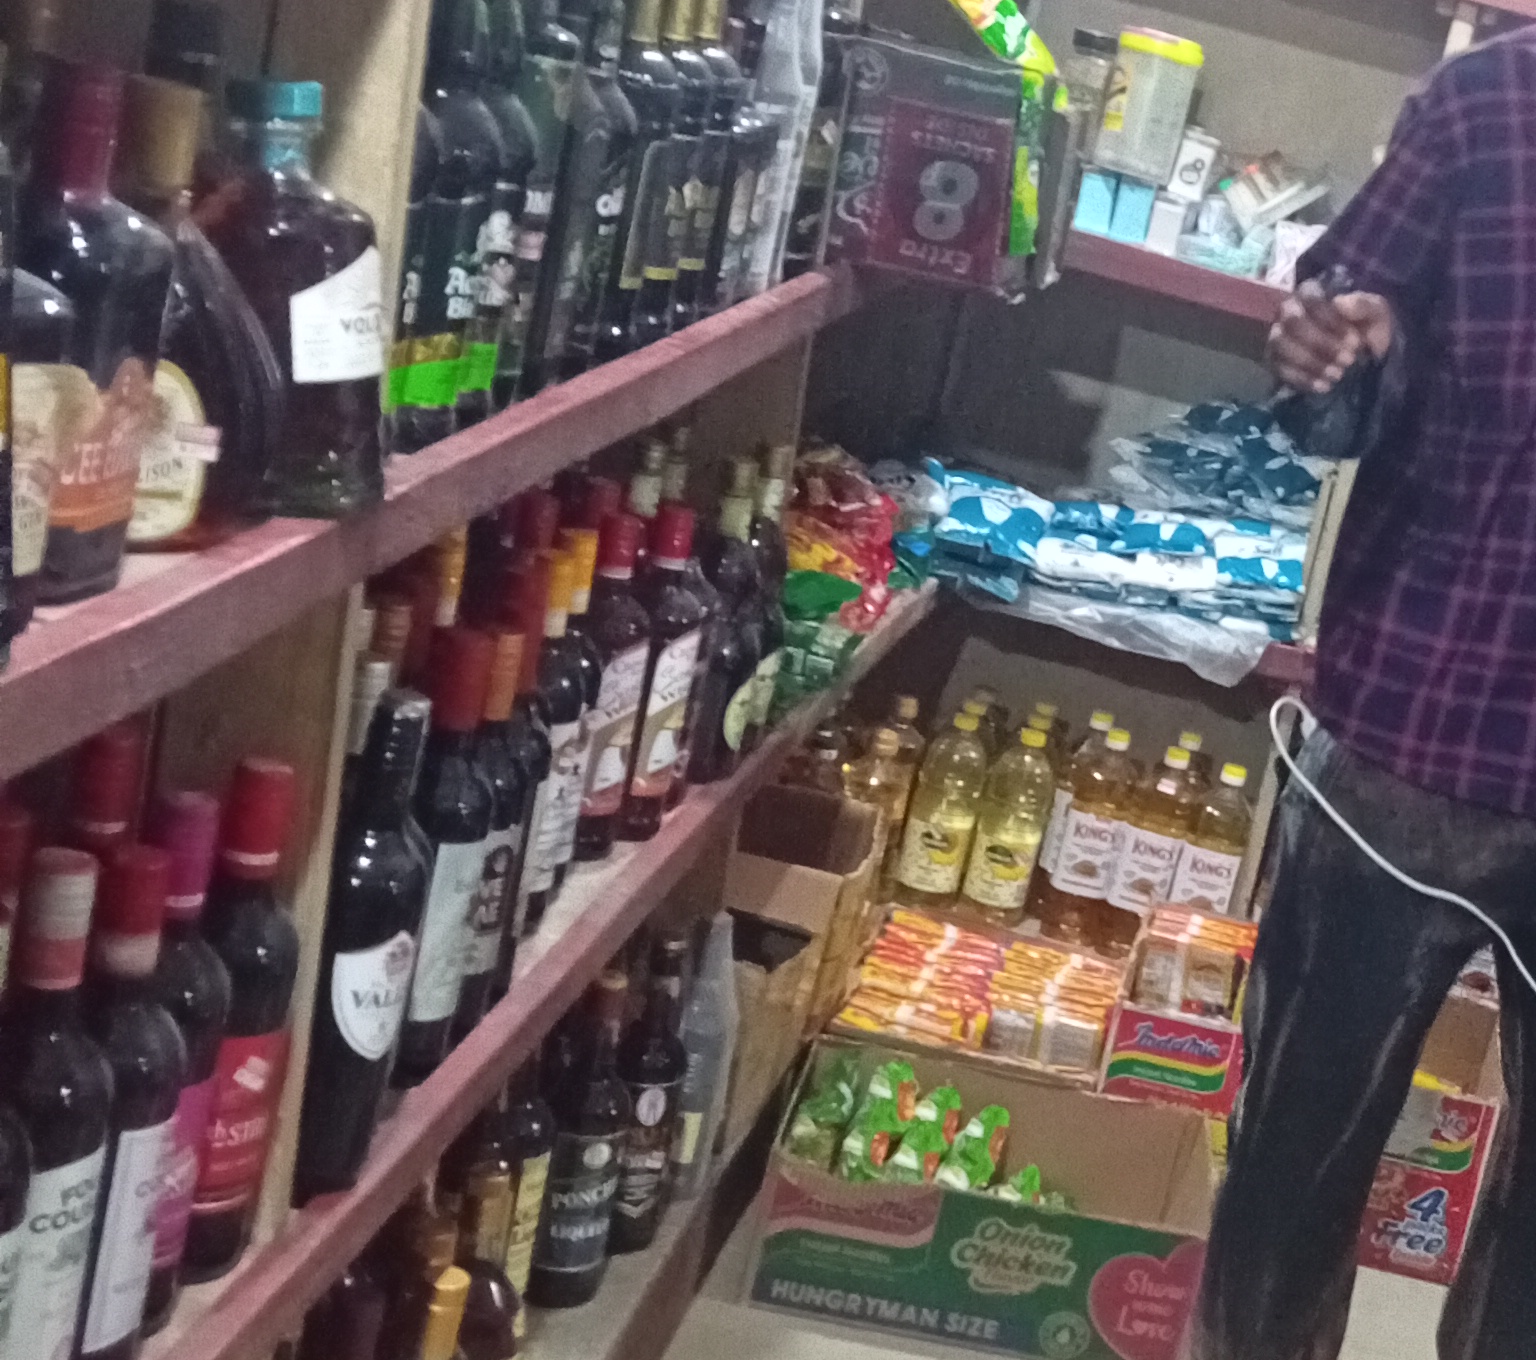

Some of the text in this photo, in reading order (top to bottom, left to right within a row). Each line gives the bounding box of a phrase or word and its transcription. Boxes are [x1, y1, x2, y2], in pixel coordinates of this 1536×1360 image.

[911, 159, 980, 241] 8
[1405, 1187, 1449, 1222] 4
[977, 1218, 1072, 1255] Onion
[956, 1240, 1075, 1283] Chicken
[770, 1278, 940, 1329] HUNGRYMAN
[944, 1310, 1001, 1342] SIZE
[1114, 1303, 1181, 1342] Love
